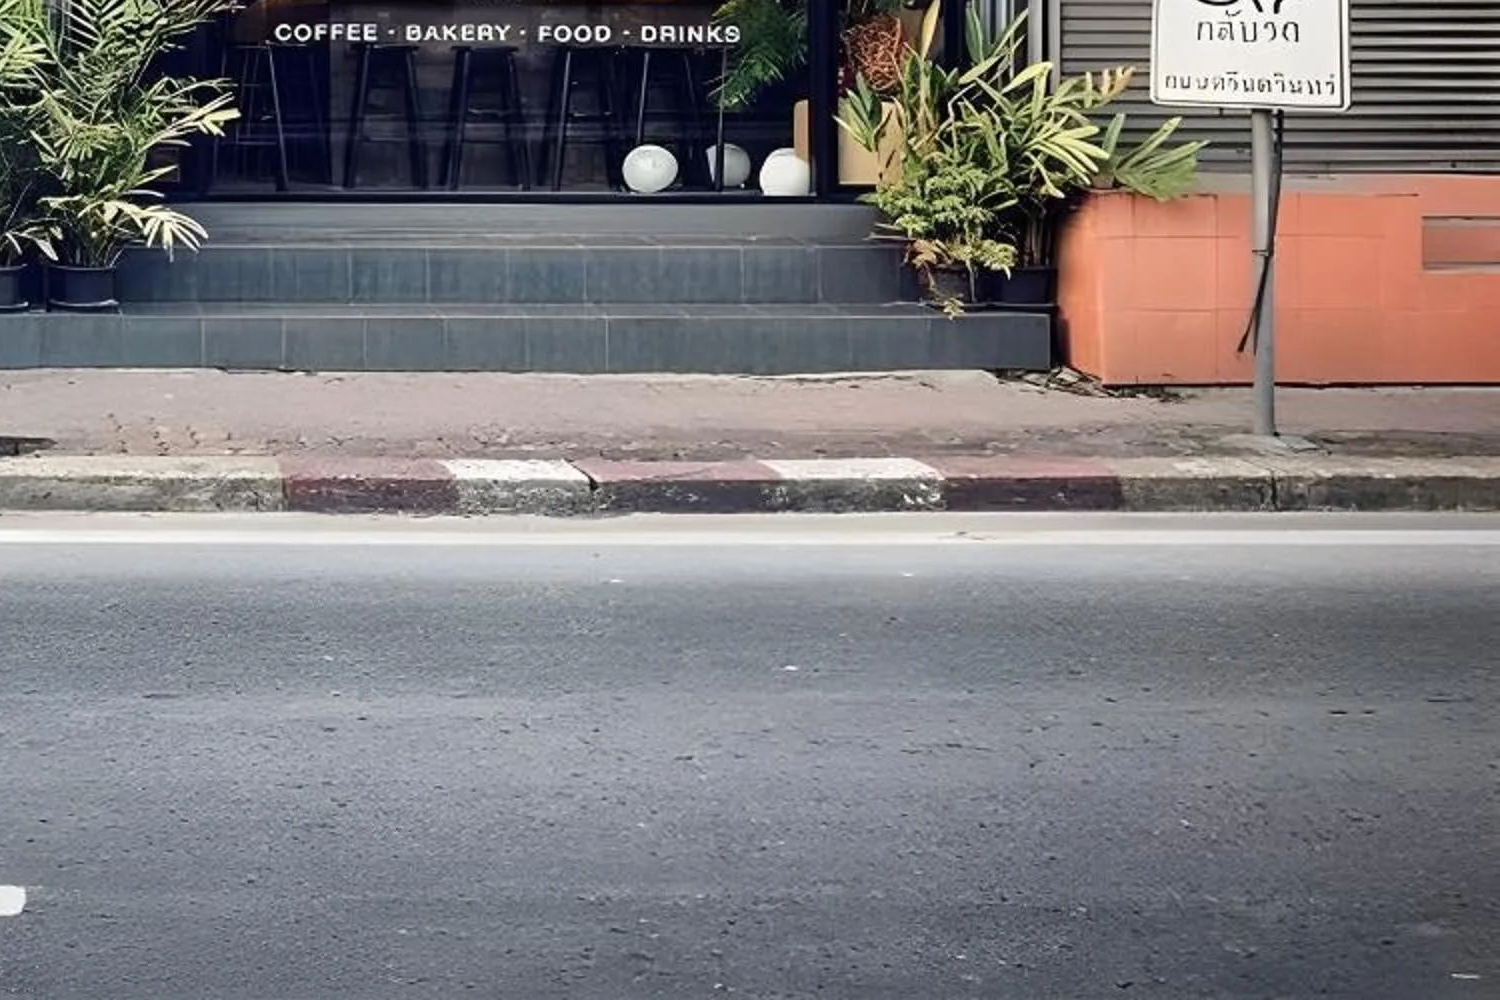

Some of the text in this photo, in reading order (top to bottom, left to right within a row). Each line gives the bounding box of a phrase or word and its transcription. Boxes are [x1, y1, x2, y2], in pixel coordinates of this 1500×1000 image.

[274, 23, 378, 42] COFFEE
[405, 23, 511, 42] BAKERY
[537, 24, 612, 43] FOOD
[641, 25, 741, 43] DRINKS
